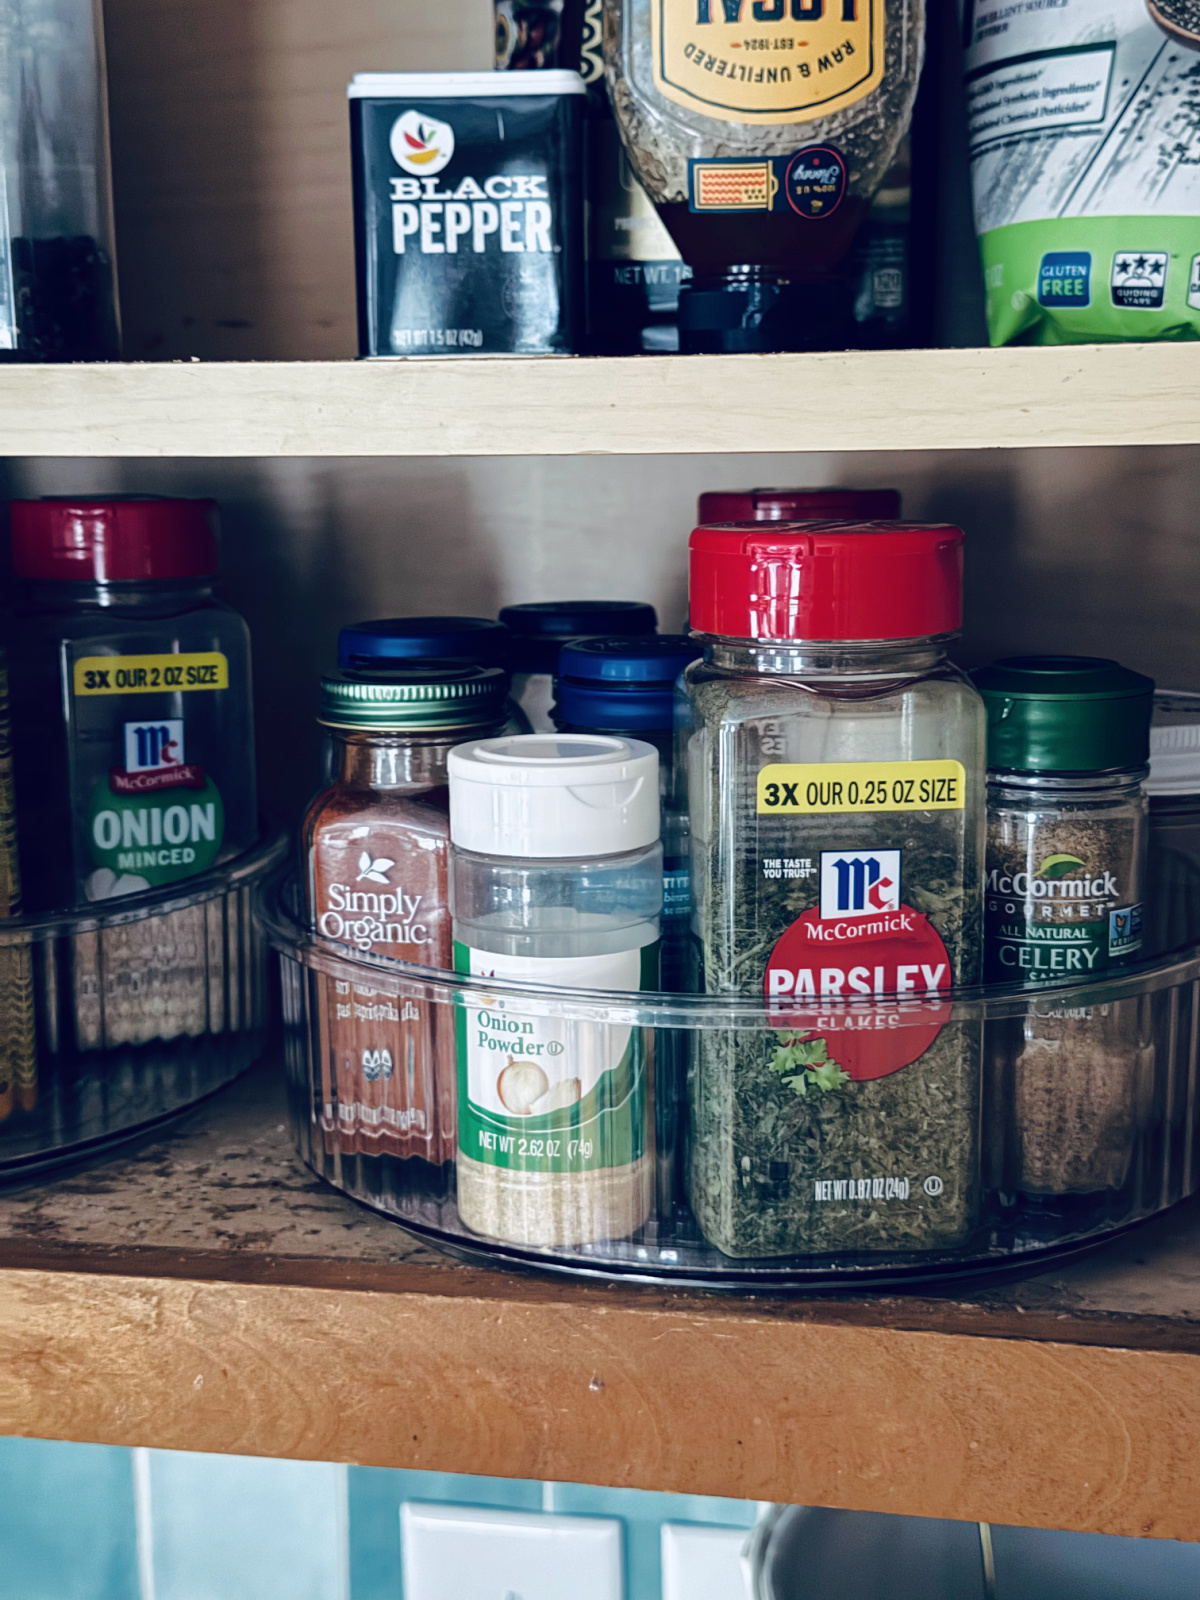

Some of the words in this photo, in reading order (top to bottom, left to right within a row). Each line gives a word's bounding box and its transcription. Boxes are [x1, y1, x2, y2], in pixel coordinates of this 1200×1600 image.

[743, 39, 770, 51] 1924
[773, 38, 794, 51] EST
[817, 38, 856, 74] RAW
[683, 42, 792, 84] UNFILTERED
[797, 63, 810, 78] &
[389, 176, 549, 200] BLACK
[391, 201, 554, 255] PEPPER
[614, 267, 641, 284] NET
[1041, 265, 1087, 277] GLUTEN
[1042, 279, 1085, 296] FREE
[1117, 289, 1159, 298] GUIDING
[446, 330, 458, 346] OZ
[84, 670, 110, 689] 3X
[116, 668, 147, 688] OUR
[150, 668, 161, 687] 2
[164, 667, 183, 685] OZ
[187, 665, 218, 684] SIZE
[114, 767, 195, 789] McCormick
[764, 783, 800, 806] 3X
[806, 781, 843, 806] OUR
[848, 780, 887, 804] 0.25
[892, 779, 915, 803] OZ
[919, 778, 957, 802] SIZE
[93, 803, 215, 850] ONION
[117, 848, 196, 869] MINCED
[763, 859, 782, 869] THE
[783, 858, 812, 869] TASTE
[763, 868, 782, 879] YOU
[985, 869, 1119, 898] McCormick
[328, 883, 422, 924] Simply
[988, 901, 1107, 918] GOURMET
[804, 913, 915, 941] McCormick
[1000, 925, 1021, 937] ALL
[1026, 927, 1089, 939] NATURAL
[1000, 945, 1100, 970] CELERY
[768, 963, 946, 1016] PARSLEY
[477, 1010, 535, 1034] Onion
[816, 1014, 900, 1032] FLAKES
[477, 1030, 545, 1055] Powder
[479, 1130, 498, 1151] NET
[499, 1135, 516, 1154] WT
[517, 1138, 544, 1157] 2.62
[546, 1139, 561, 1157] OZ
[567, 1138, 593, 1160] (74g)
[815, 1181, 832, 1200] NET
[833, 1180, 847, 1200] WT
[848, 1179, 871, 1199] 0.87
[872, 1178, 885, 1199] OZ
[885, 1177, 909, 1200] (24g)
